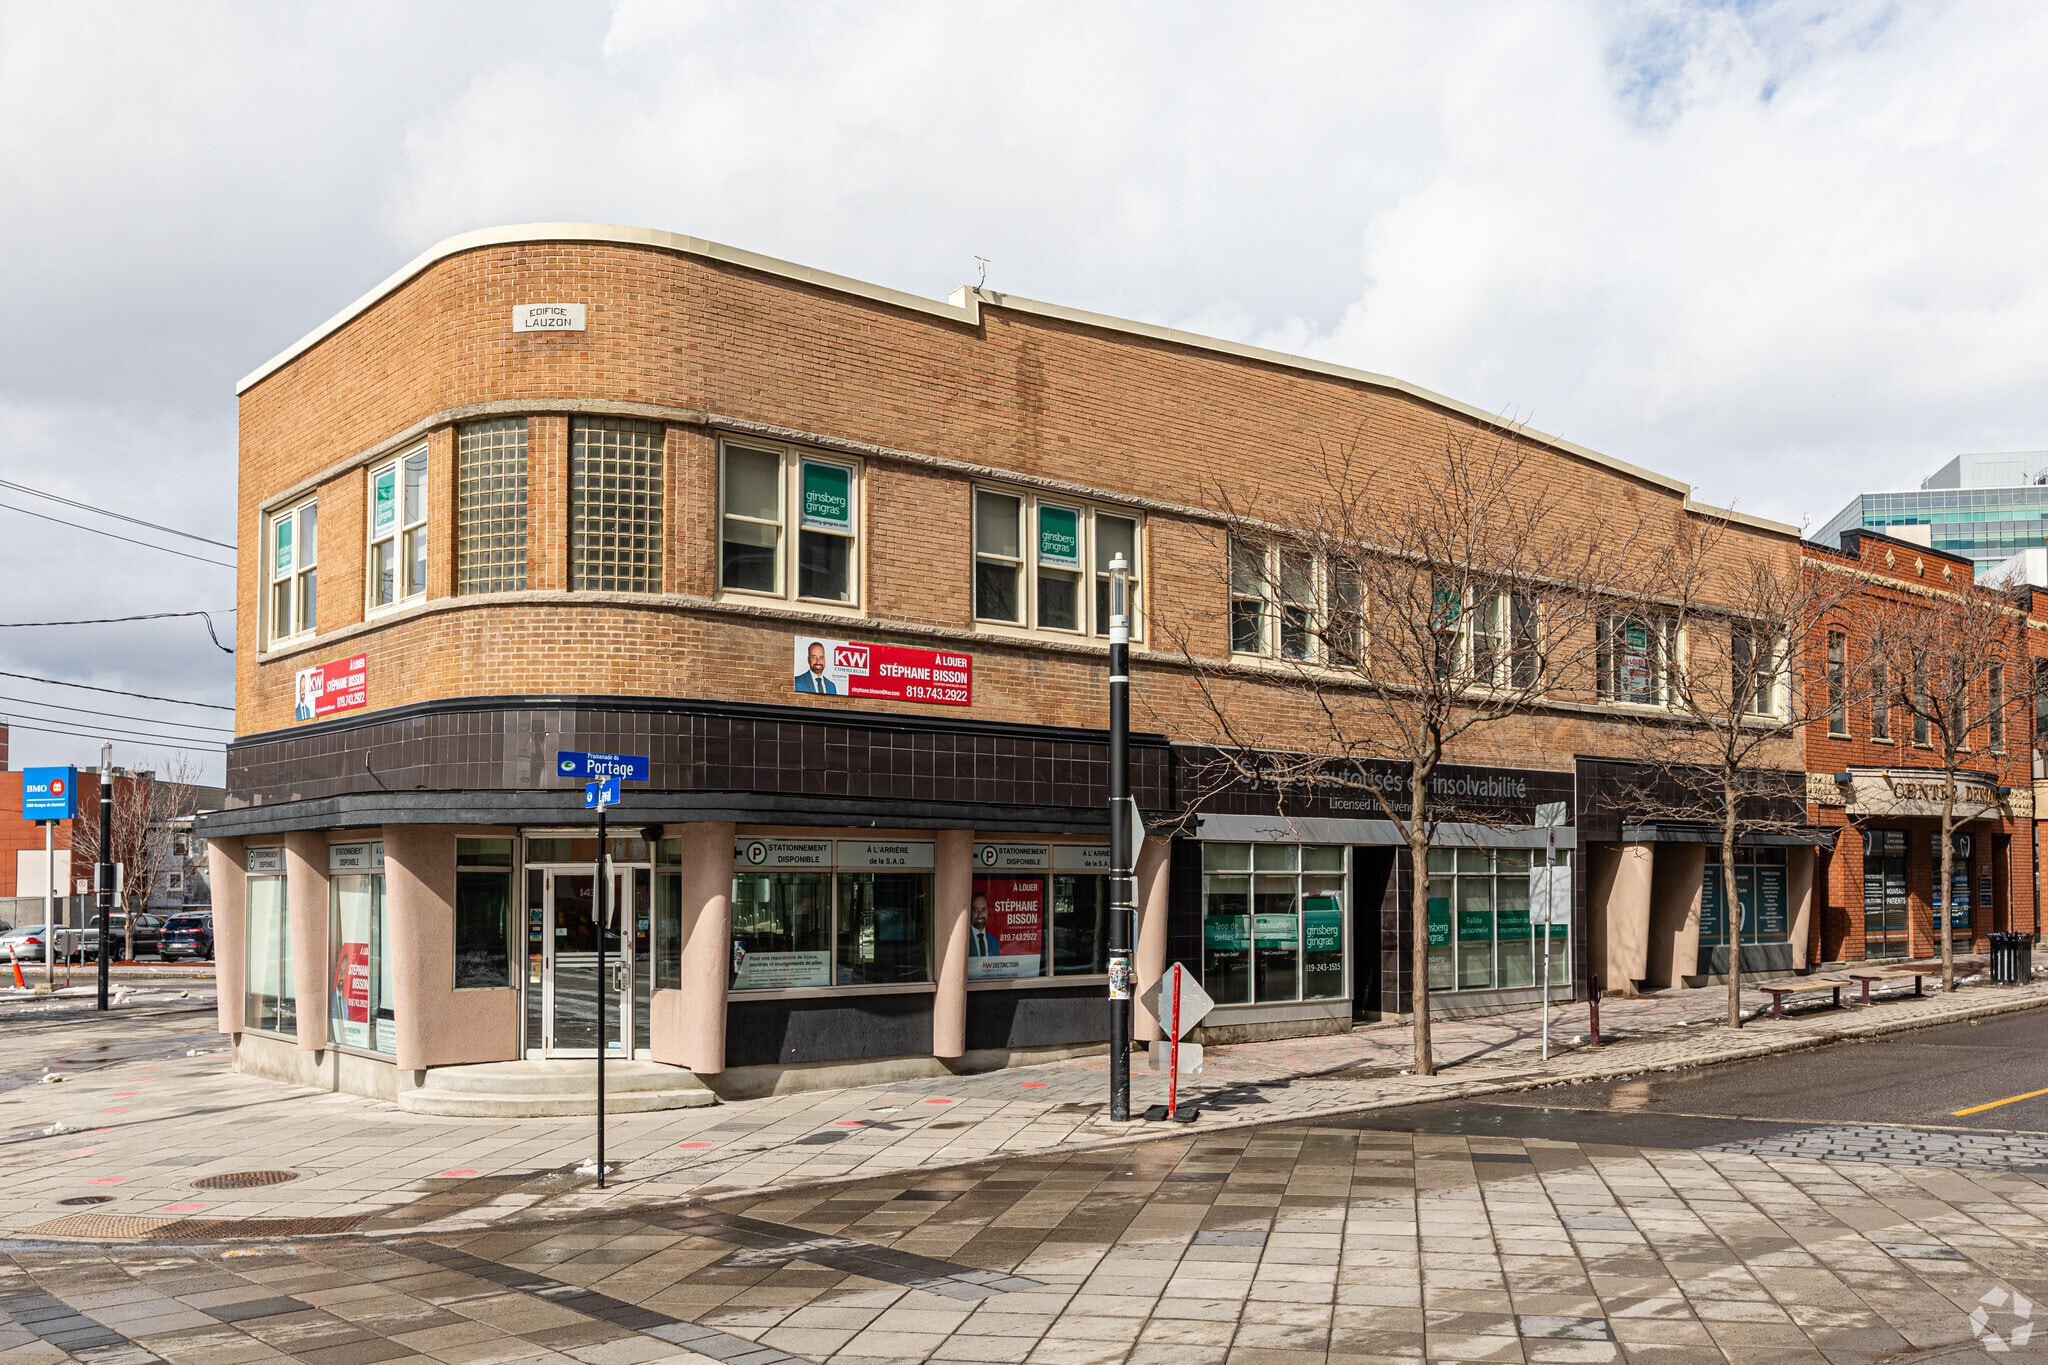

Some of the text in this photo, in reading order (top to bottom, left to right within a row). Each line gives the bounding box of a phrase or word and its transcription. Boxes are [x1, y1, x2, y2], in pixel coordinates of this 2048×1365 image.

[530, 308, 567, 317] EDIFICE
[526, 318, 572, 328] LAUZON
[806, 490, 846, 508] ginsberg
[806, 500, 840, 515] gingras
[1042, 530, 1074, 546] ginsberg
[1042, 540, 1070, 552] gingras
[834, 650, 868, 668] KW
[935, 654, 968, 668] À LOUER
[880, 663, 968, 684] STÉPHANE BISSON
[906, 686, 968, 702] 819.743.2922
[588, 752, 613, 760] Promenade
[587, 760, 634, 780] Portage
[26, 784, 48, 792] BMO
[1433, 772, 1526, 798] insolvabilité
[1330, 797, 1371, 811] Licensed
[1372, 798, 1413, 813] Inlvenc
[336, 846, 364, 856] STATIONNEMENT
[768, 844, 828, 852] STATIONNEMENT
[867, 844, 909, 854] À L'ARRIÈRE
[998, 848, 1048, 856] STATIONNEMENT
[1088, 849, 1110, 857] L'ARRIÈ
[339, 858, 360, 866] DISPONIBLE
[778, 855, 820, 864] DISPONIBLE
[886, 858, 906, 866] S.A.Q.
[1013, 882, 1038, 892] À LOUER
[994, 898, 1038, 912] STÉPHANE
[1007, 914, 1038, 925] BISSON
[1214, 922, 1229, 932] Trop
[1306, 924, 1338, 938] ginsberg
[1000, 933, 1037, 942] 819.743.2922
[1214, 933, 1234, 941] dettes
[1306, 936, 1334, 948] gingras
[348, 962, 369, 976] STÉPHAN
